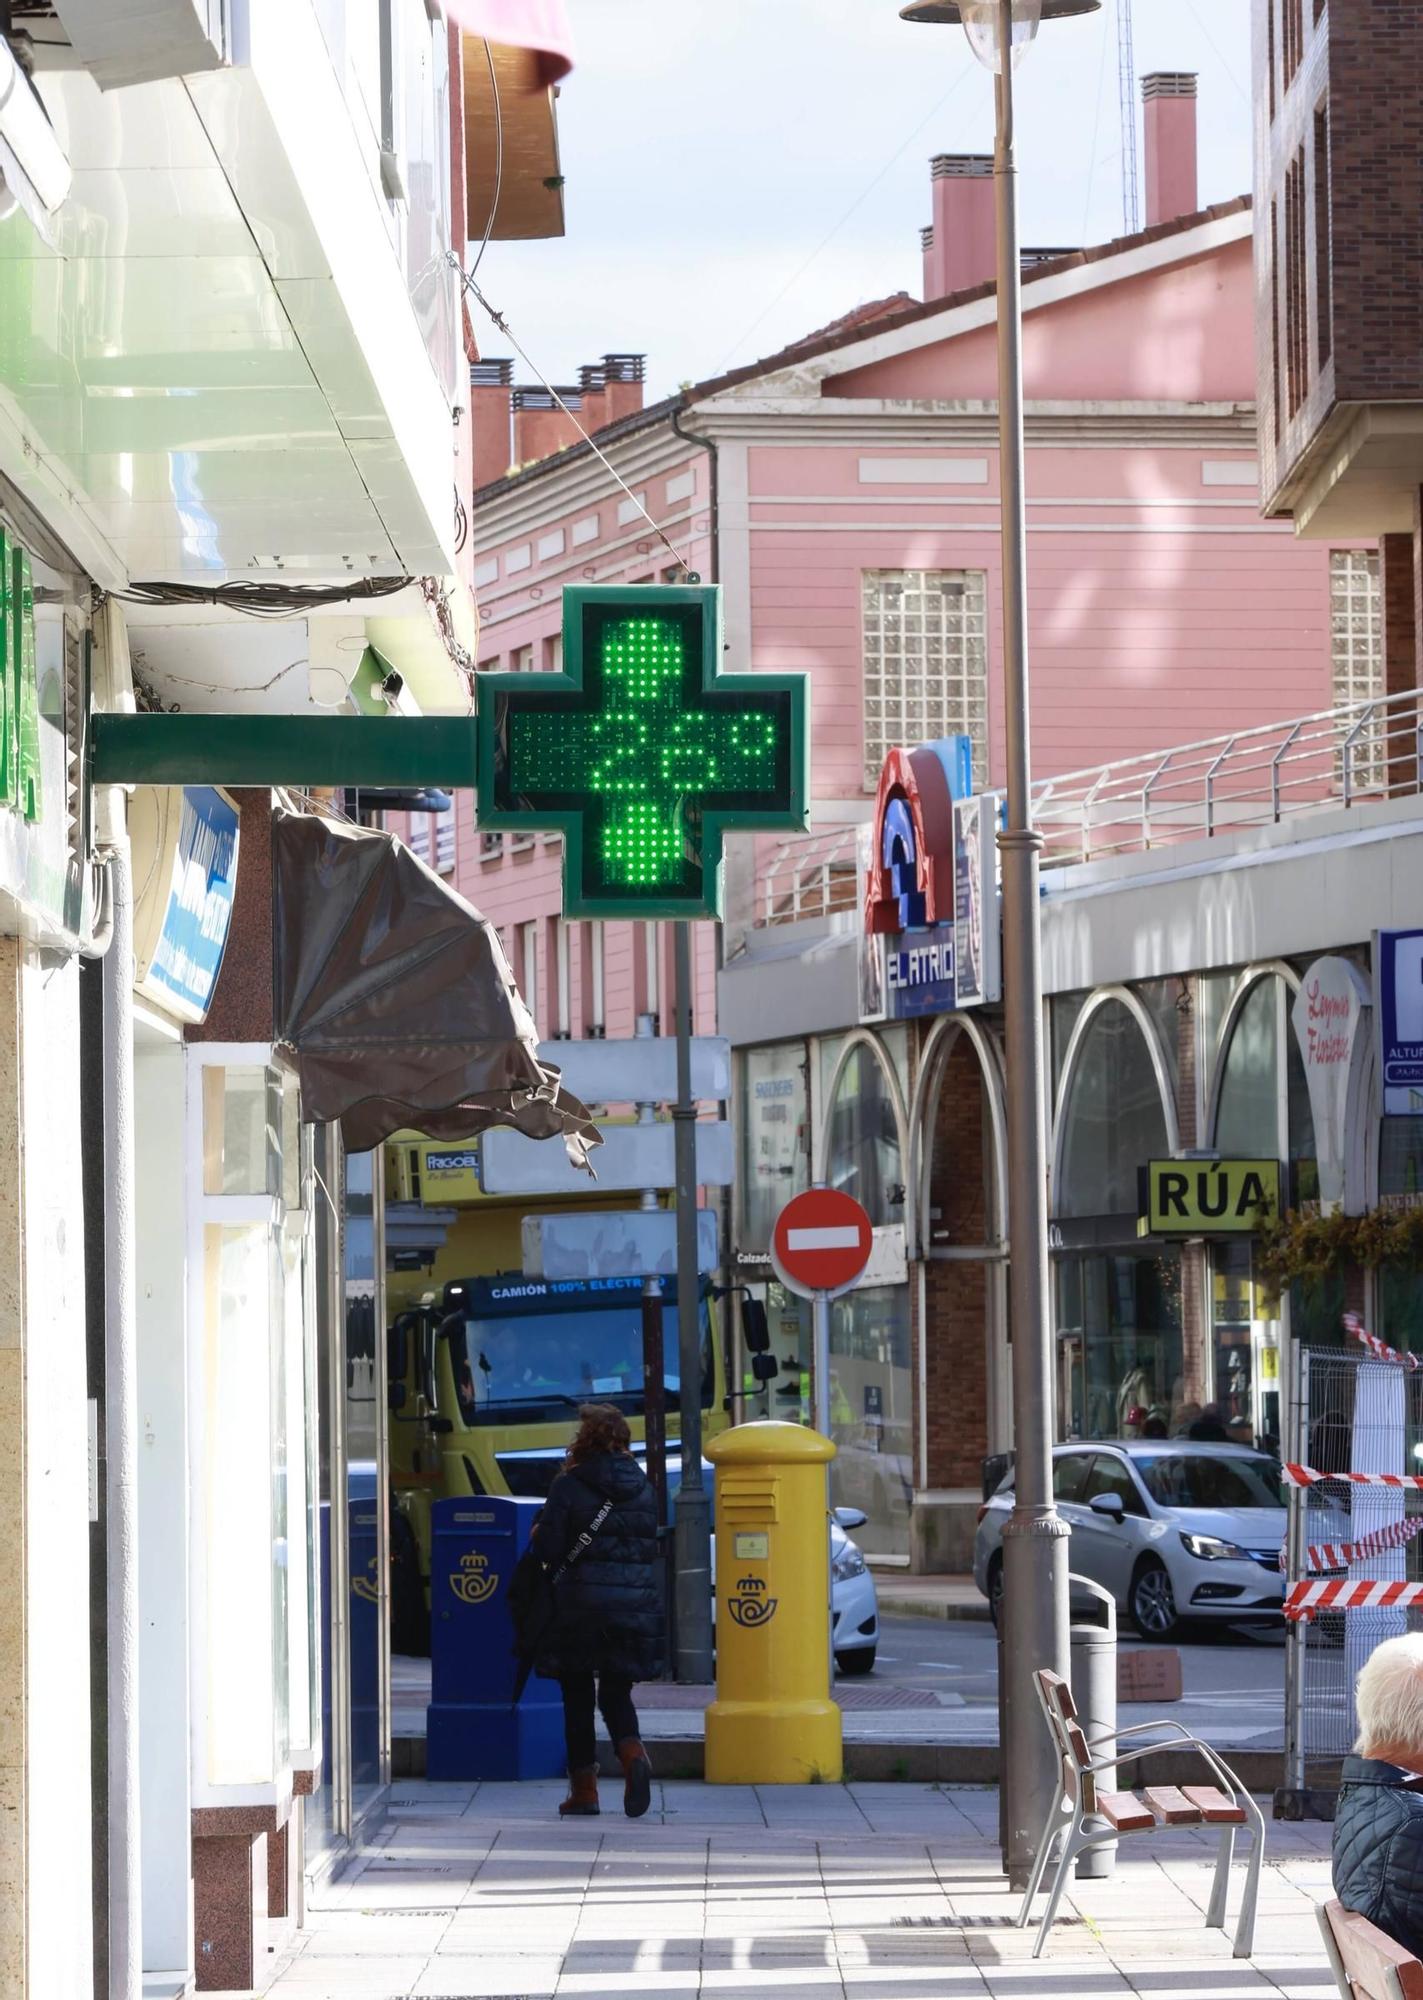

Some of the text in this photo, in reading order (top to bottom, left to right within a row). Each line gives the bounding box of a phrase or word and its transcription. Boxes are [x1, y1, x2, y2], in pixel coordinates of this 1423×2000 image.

[888, 942, 954, 988] EL ATRIO
[1159, 1162, 1270, 1217] RÚA
[492, 1277, 665, 1299] CAMIÓN 100% ELÉCTRO
